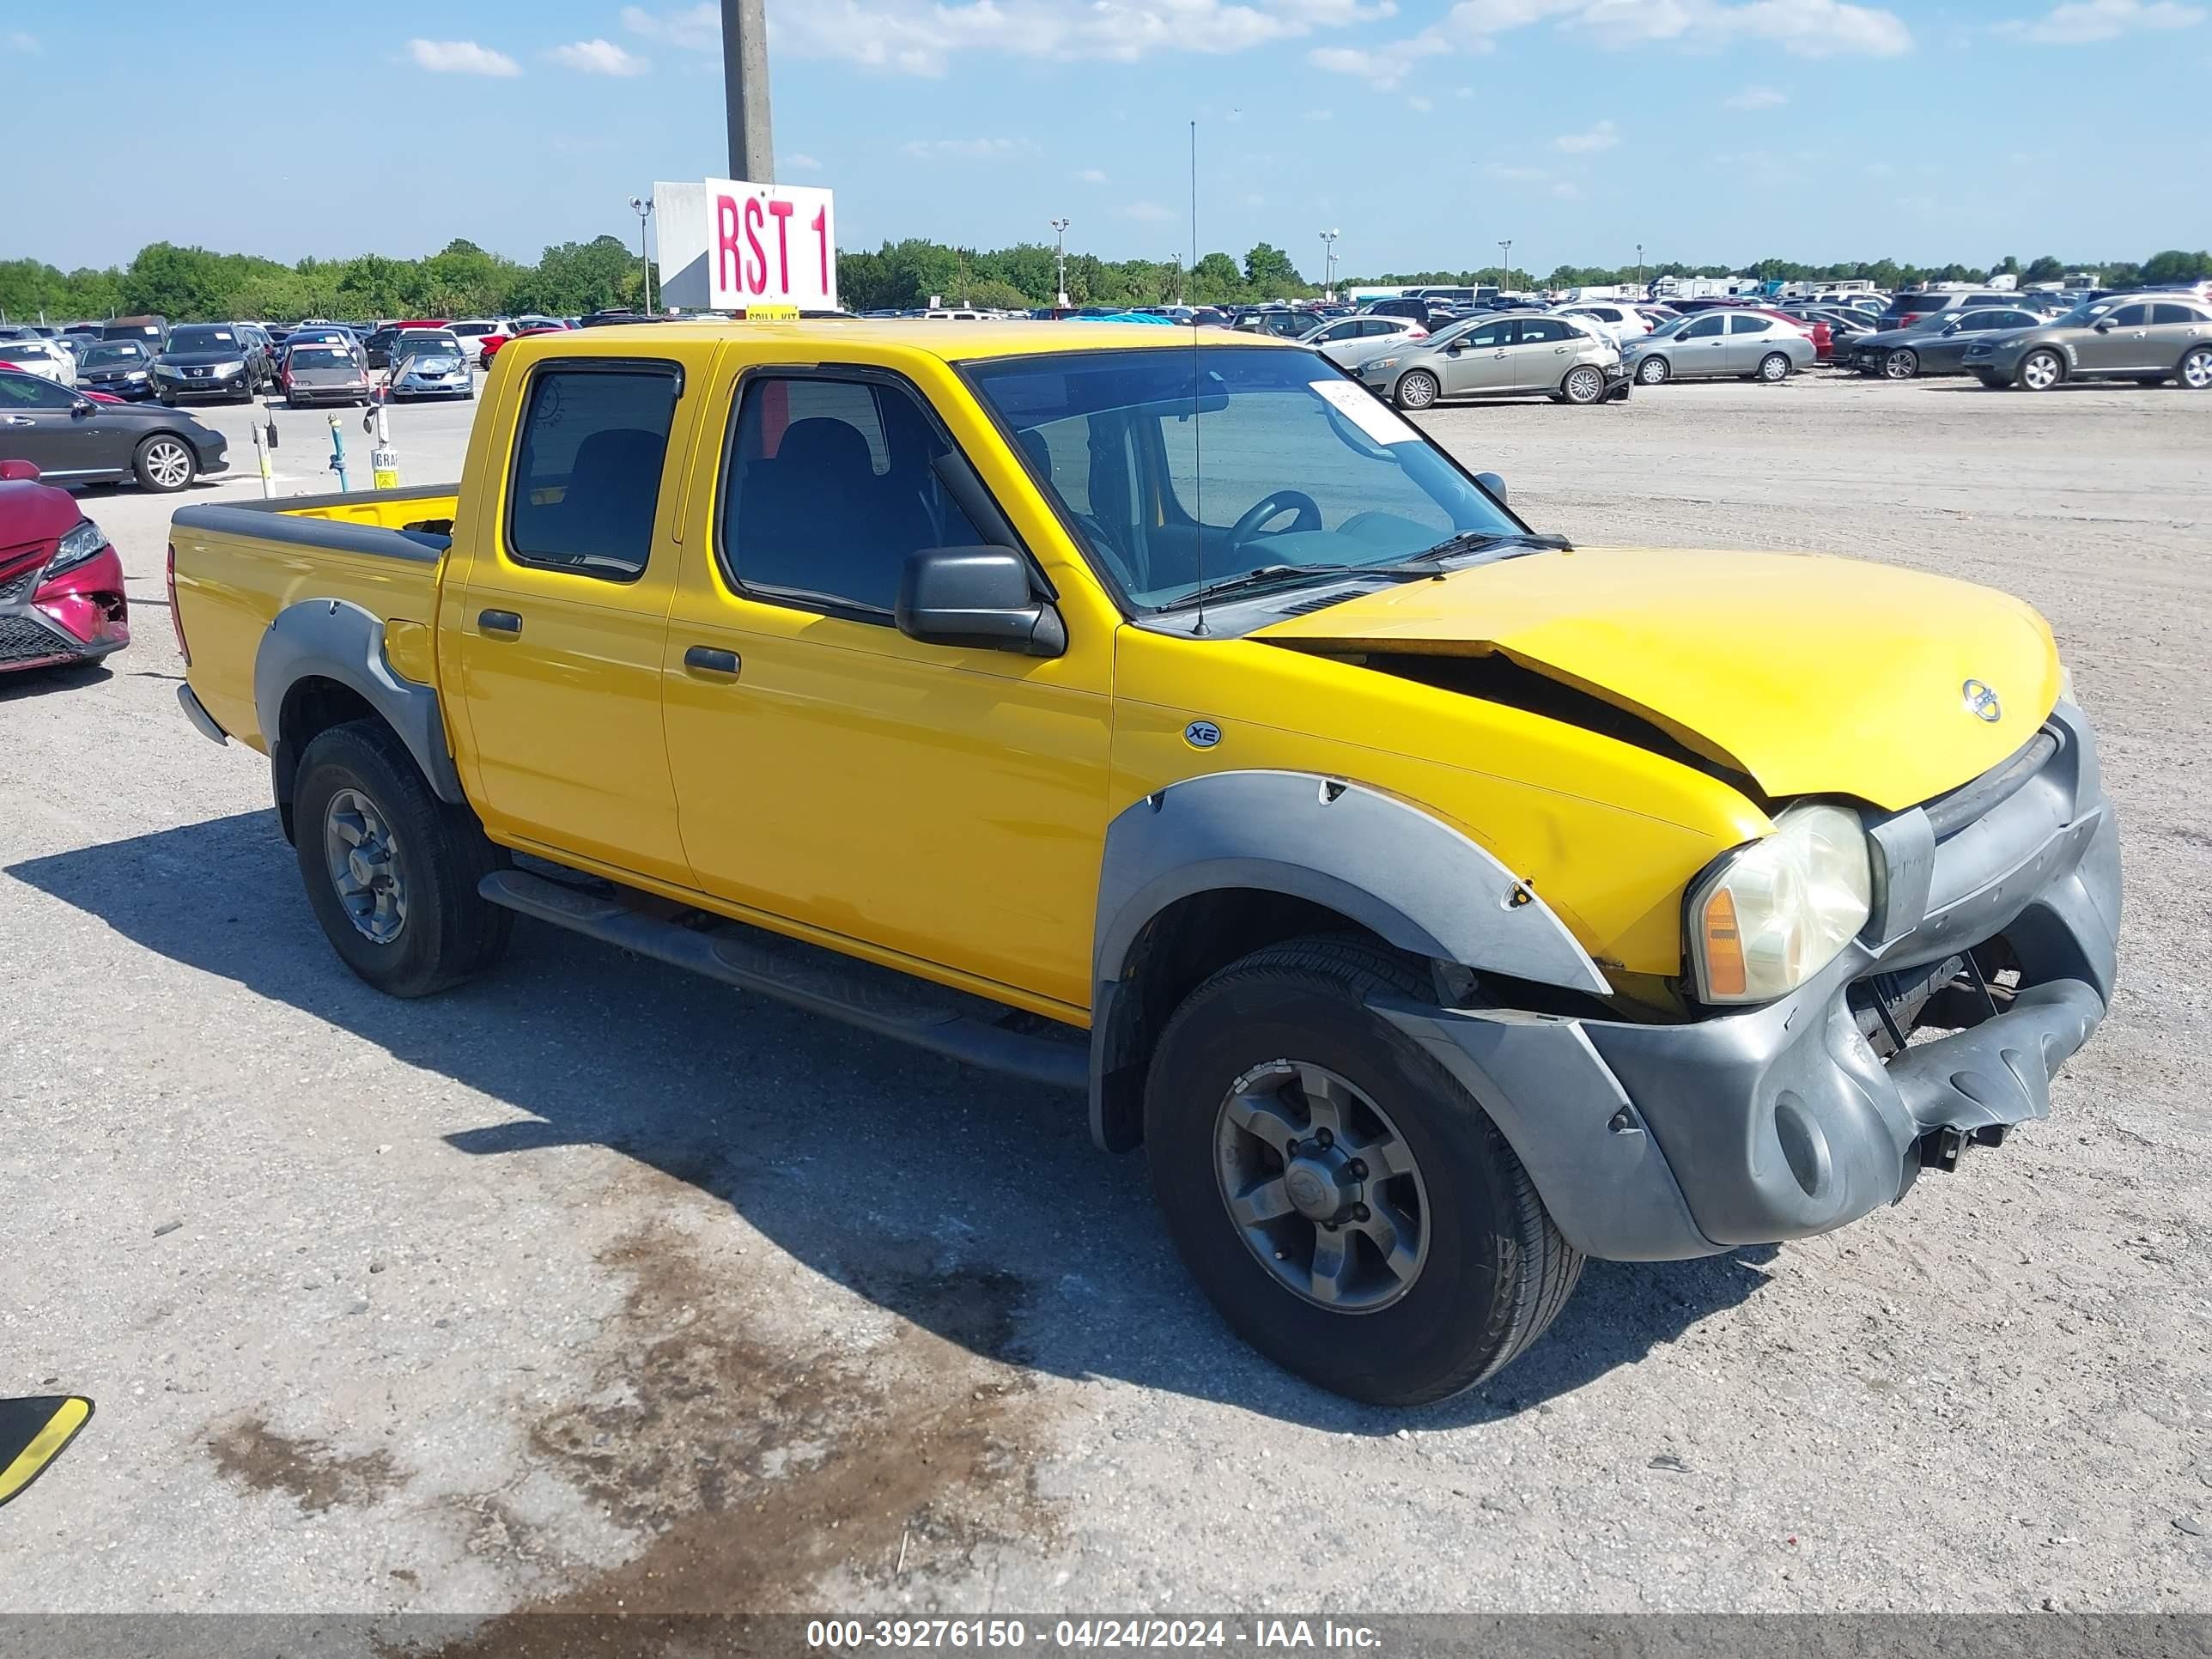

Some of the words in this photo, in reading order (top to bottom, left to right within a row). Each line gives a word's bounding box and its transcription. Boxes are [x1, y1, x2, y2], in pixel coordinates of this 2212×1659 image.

[717, 194, 793, 295] RST
[811, 204, 829, 295] 1
[1188, 726, 1218, 742] XE
